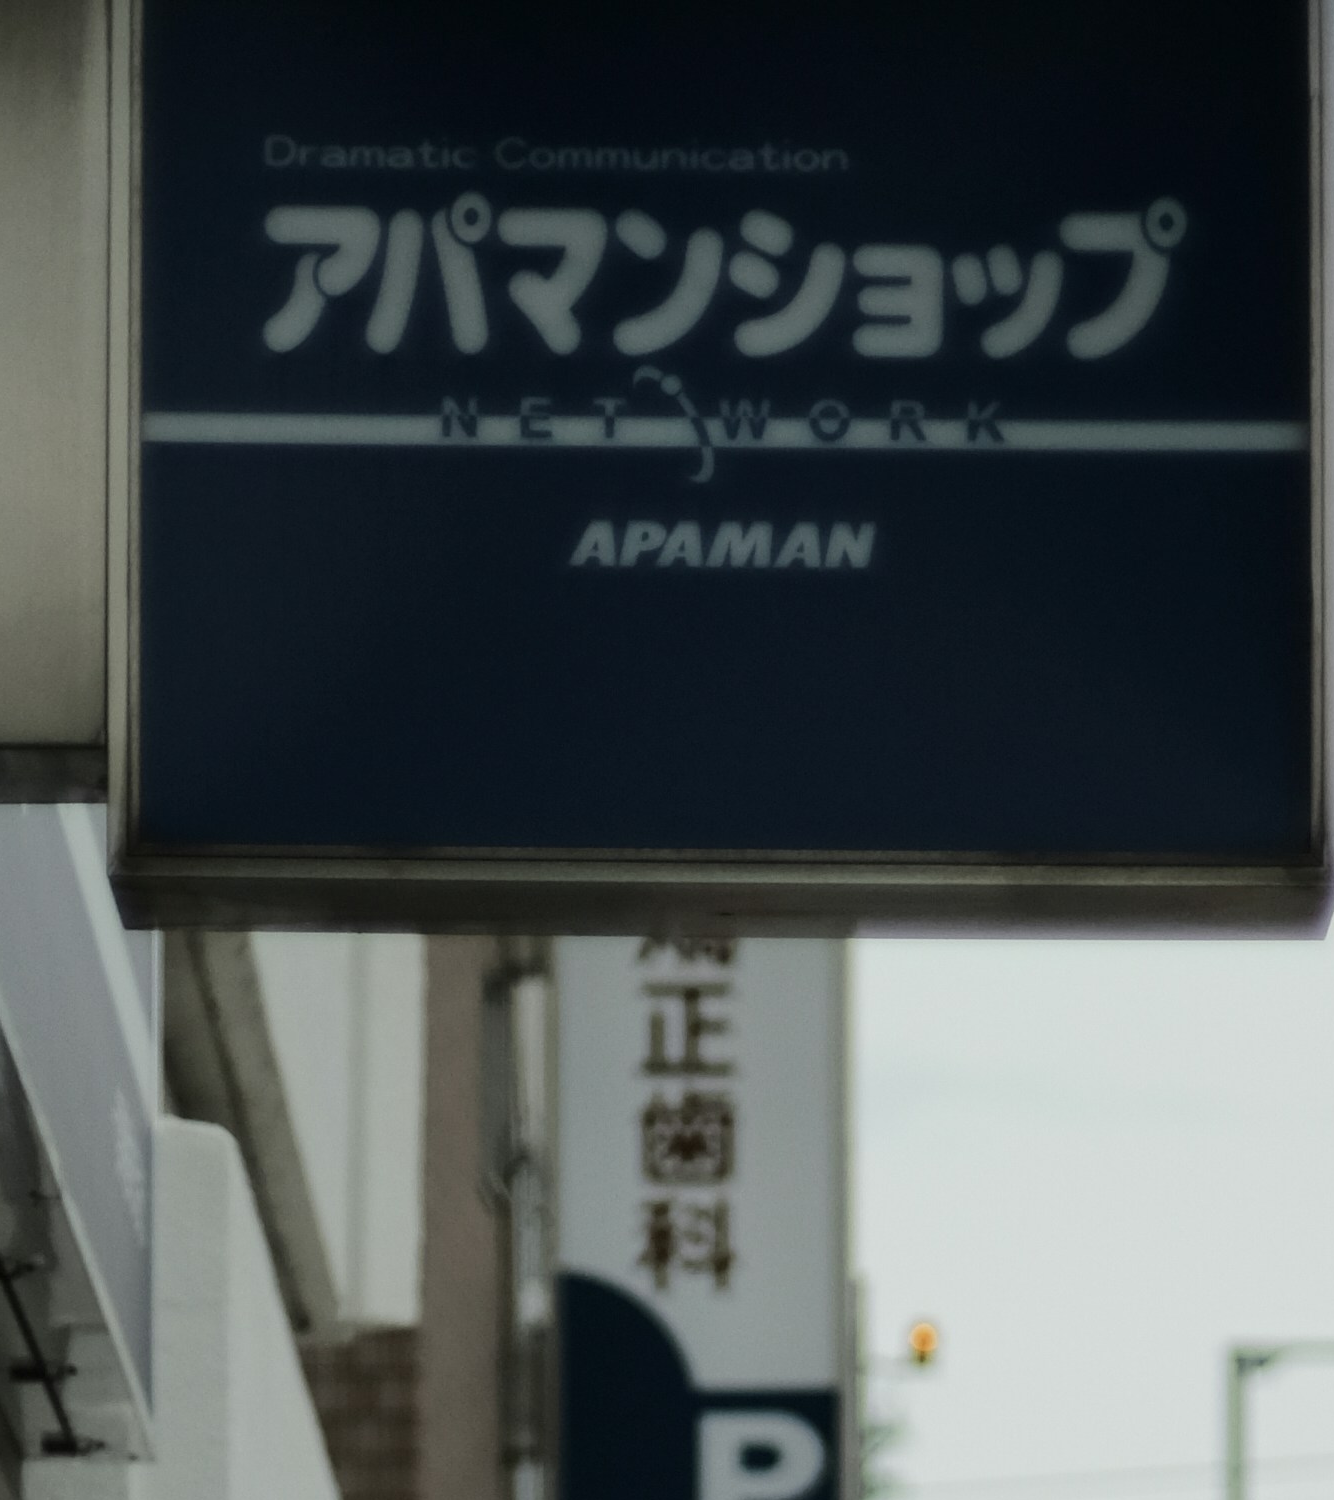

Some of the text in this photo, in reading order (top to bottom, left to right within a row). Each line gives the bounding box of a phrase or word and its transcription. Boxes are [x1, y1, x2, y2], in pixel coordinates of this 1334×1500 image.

[264, 133, 850, 174] Dramatic Communication
[264, 192, 1187, 359] アパマンショップ
[569, 521, 875, 568] APAMAN
